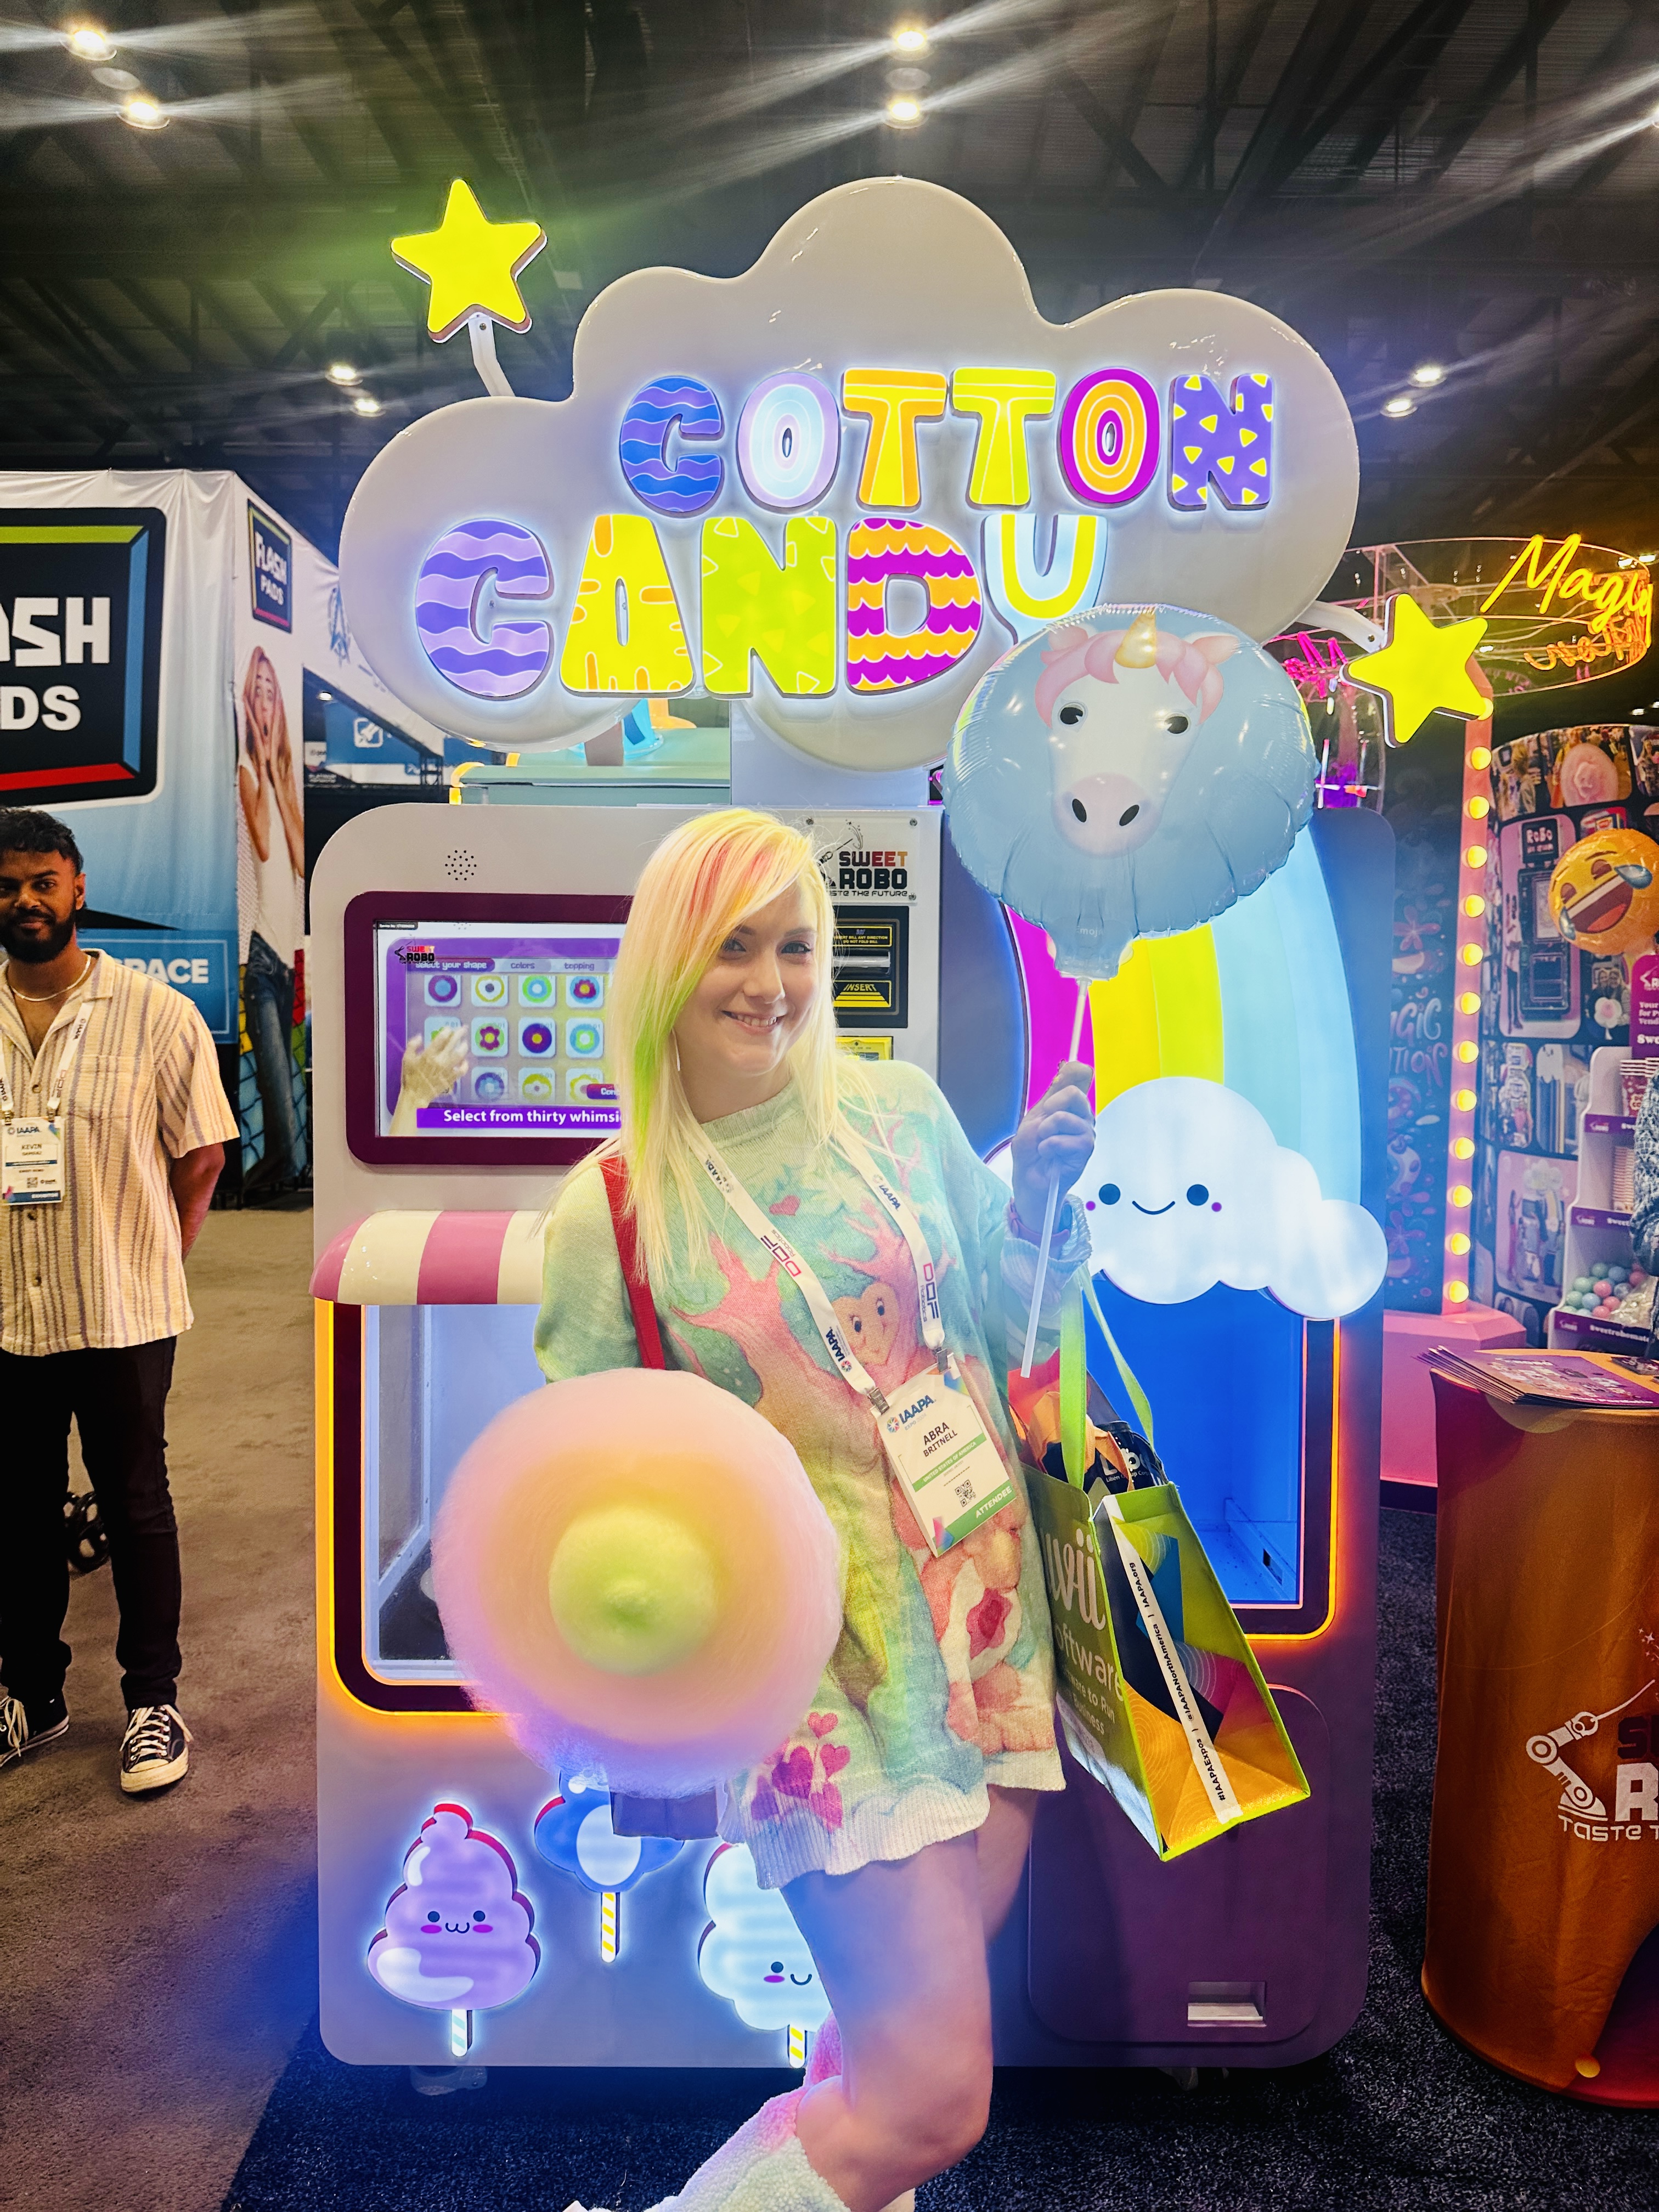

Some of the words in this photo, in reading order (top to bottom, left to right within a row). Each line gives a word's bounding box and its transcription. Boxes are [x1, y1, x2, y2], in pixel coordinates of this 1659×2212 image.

[619, 366, 1274, 515] COTTON
[255, 531, 287, 585] FLASH
[260, 574, 284, 605] PADS
[415, 512, 1107, 698] CANDY
[0, 597, 110, 667] SH
[839, 851, 908, 867] SWEET
[839, 868, 907, 889] ROBO
[114, 958, 210, 984] PACE
[407, 952, 435, 962] ROBO
[442, 962, 461, 971] your
[463, 961, 487, 970] shape
[843, 983, 877, 992] INSERT
[443, 1109, 486, 1122] Select
[489, 1109, 523, 1122] from
[527, 1110, 566, 1125] thirty
[878, 1184, 901, 1211] IAAPA
[760, 1235, 802, 1278] DOF
[923, 1262, 939, 1319] DOF
[826, 1328, 845, 1363] IAAPA
[898, 1395, 935, 1424] IAAPA
[923, 1421, 950, 1446] ABRA
[923, 1430, 958, 1457] BRITNELL
[923, 1467, 939, 1482] UNITED
[938, 1458, 953, 1472] STATES
[958, 1441, 977, 1458] AMERICA
[975, 1485, 1013, 1519] ATTENDEE
[1129, 1562, 1150, 1608] IAAPA.org
[1153, 1623, 1195, 1722] @IAAPANorthAmerica
[1100, 1695, 1116, 1724] Run
[1197, 1738, 1226, 1801] #IAAPAExpos
